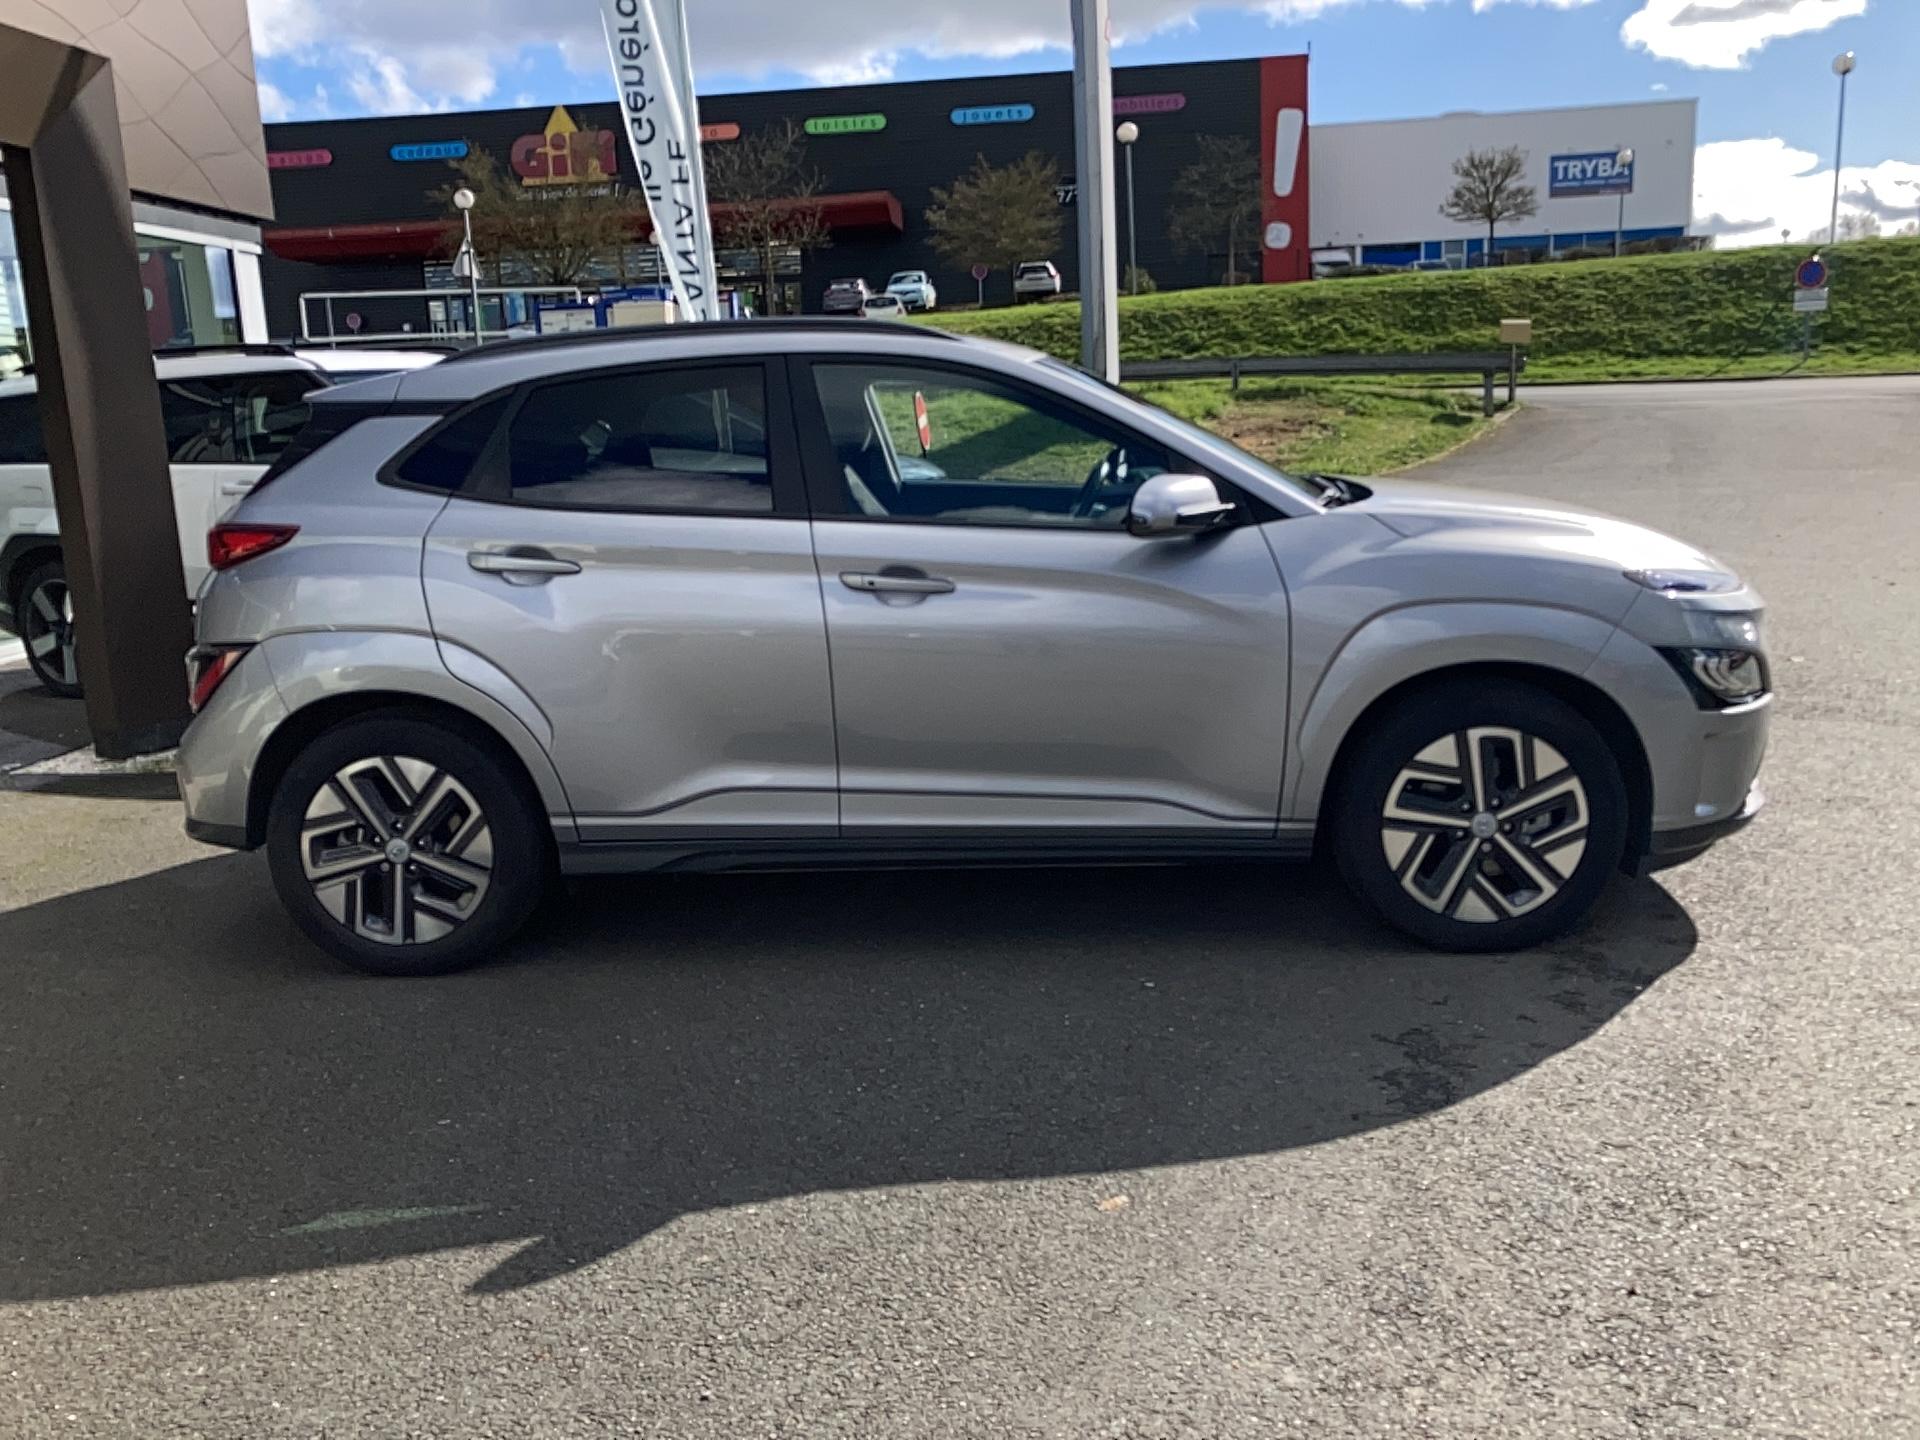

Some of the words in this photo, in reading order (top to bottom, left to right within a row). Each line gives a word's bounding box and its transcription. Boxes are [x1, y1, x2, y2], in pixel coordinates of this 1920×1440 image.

[961, 108, 1024, 124] jouets
[813, 118, 878, 132] loisirs
[1554, 158, 1630, 180] TRYBA
